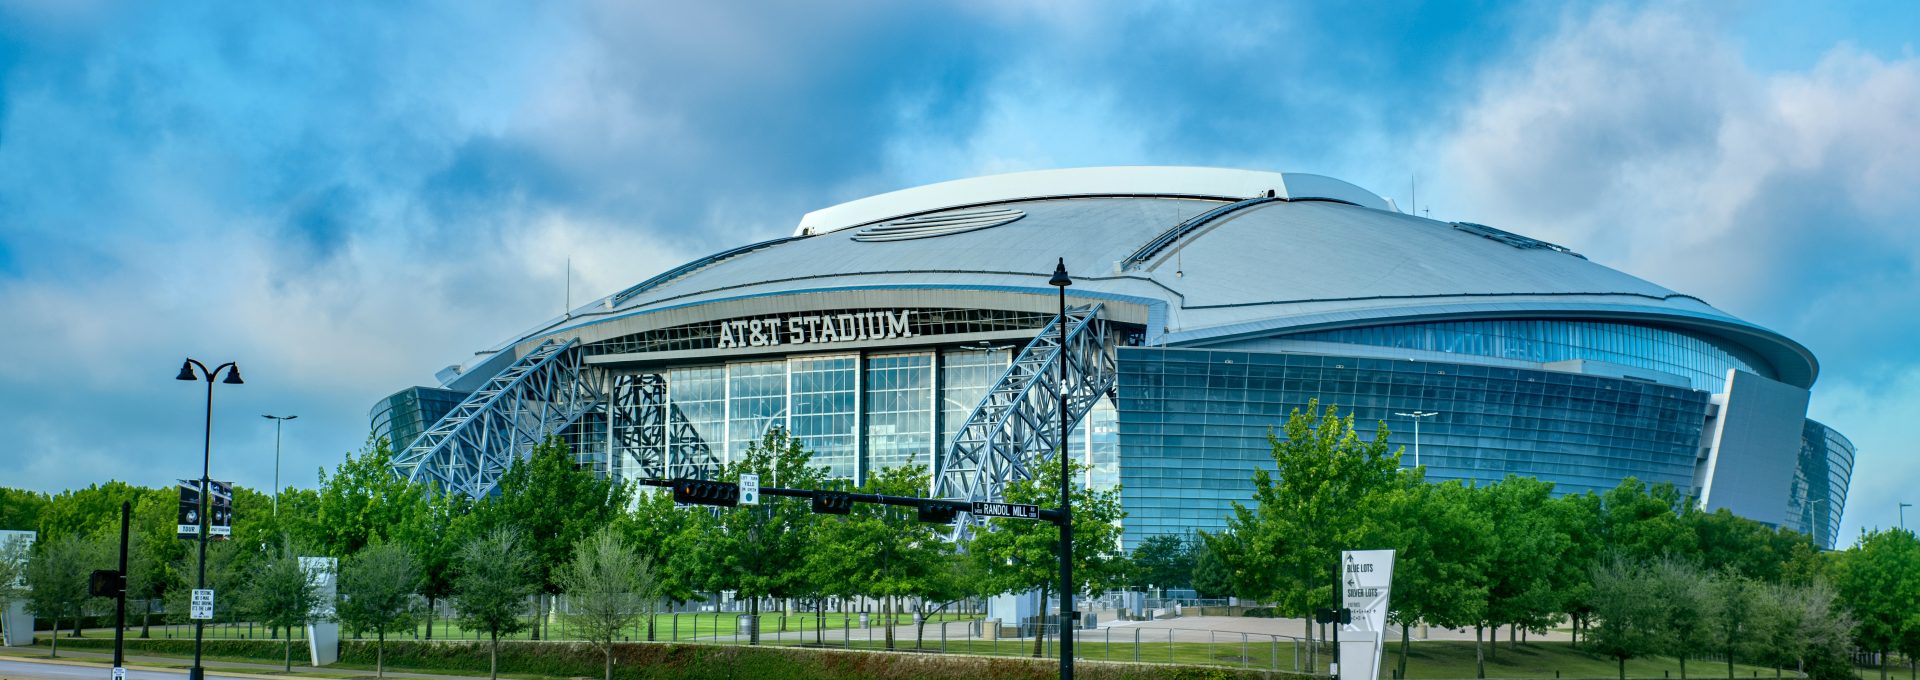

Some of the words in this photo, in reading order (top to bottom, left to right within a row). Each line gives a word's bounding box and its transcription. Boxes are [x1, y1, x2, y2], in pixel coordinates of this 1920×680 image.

[718, 318, 781, 349] AT&T
[788, 310, 912, 344] STADIUM
[983, 504, 1010, 516] RANDOL
[1012, 505, 1027, 517] MILL
[1347, 564, 1360, 573] BLUE
[1361, 563, 1373, 573] LOTS
[1347, 588, 1364, 597] SILVER
[1365, 588, 1378, 597] LOTS
